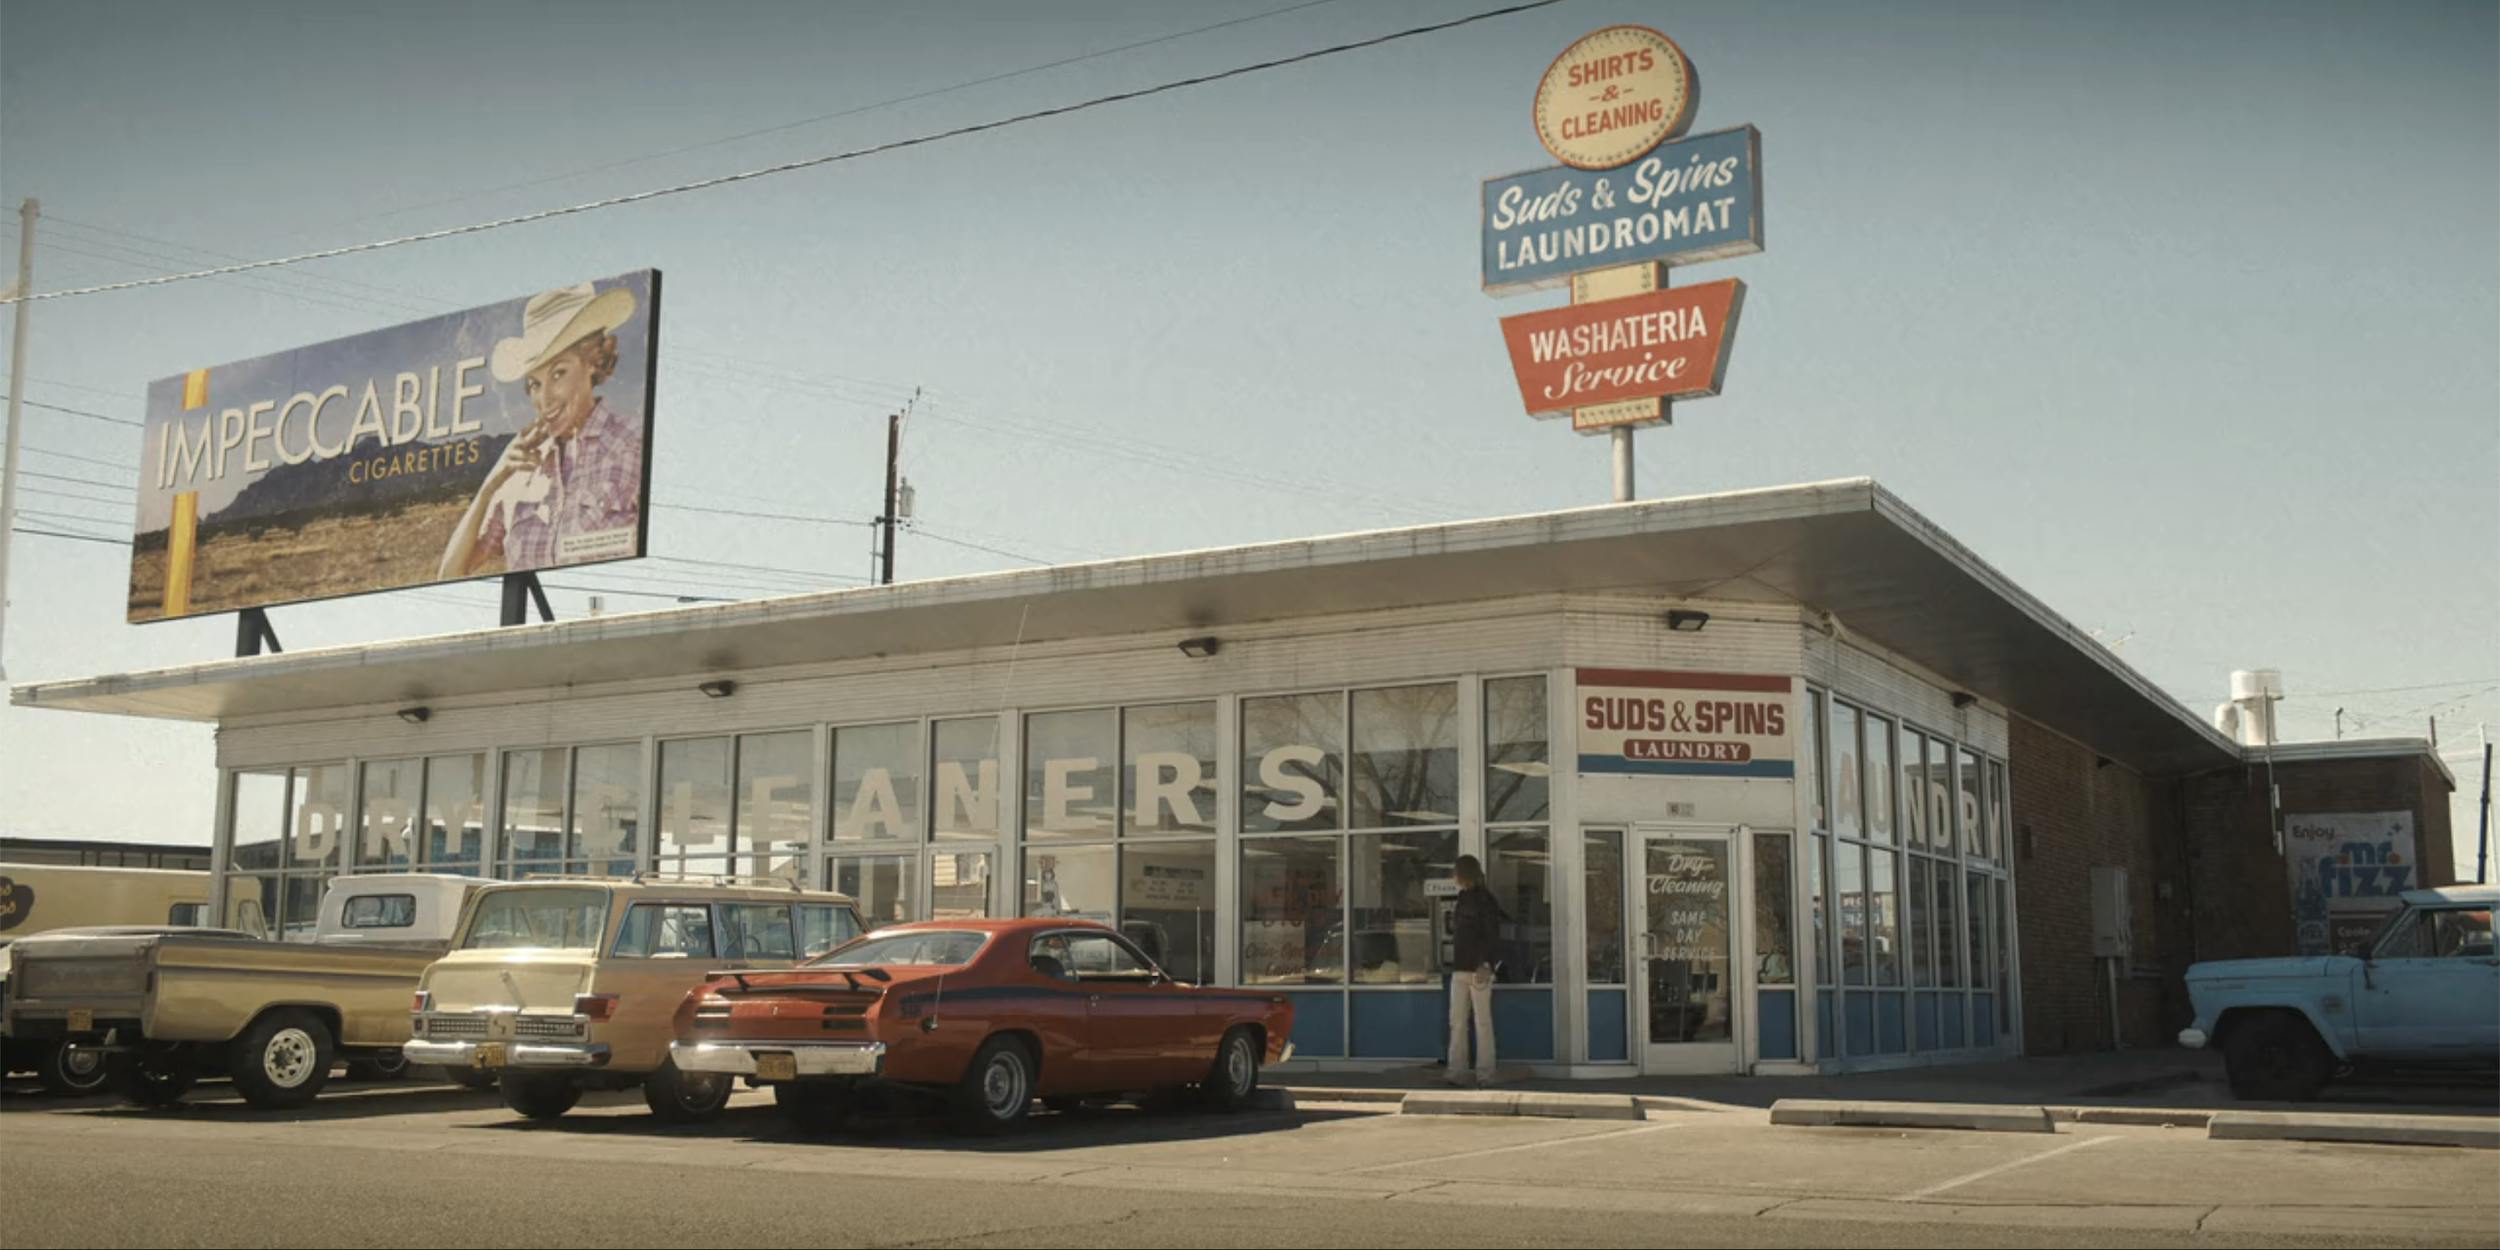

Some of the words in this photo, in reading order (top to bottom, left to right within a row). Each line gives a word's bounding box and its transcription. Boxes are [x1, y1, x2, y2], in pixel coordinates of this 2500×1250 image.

[1568, 48, 1655, 87] SHIRTS
[1561, 99, 1664, 140] CLEANING
[1492, 180, 1582, 231] Suds
[1592, 178, 1616, 208] &
[1627, 155, 1738, 209] Spins
[1498, 197, 1736, 270] LAUNDROMAT
[1529, 304, 1708, 364] WASHATERIA
[1544, 351, 1687, 400] Service
[156, 355, 487, 491] IMPECCABLE
[348, 438, 481, 485] CIGARETTES
[1585, 696, 1666, 732] SUDS
[1670, 700, 1693, 734] &
[1694, 700, 1786, 736] SPINS
[1633, 741, 1743, 761] LAUNDRY
[294, 796, 476, 861] DRY
[582, 744, 1326, 853] CLEANERS
[2292, 825, 2335, 842] Enjoy
[1649, 876, 1724, 900] Cleaning
[1671, 910, 1706, 926] SAME
[1676, 928, 1704, 943] DAY
